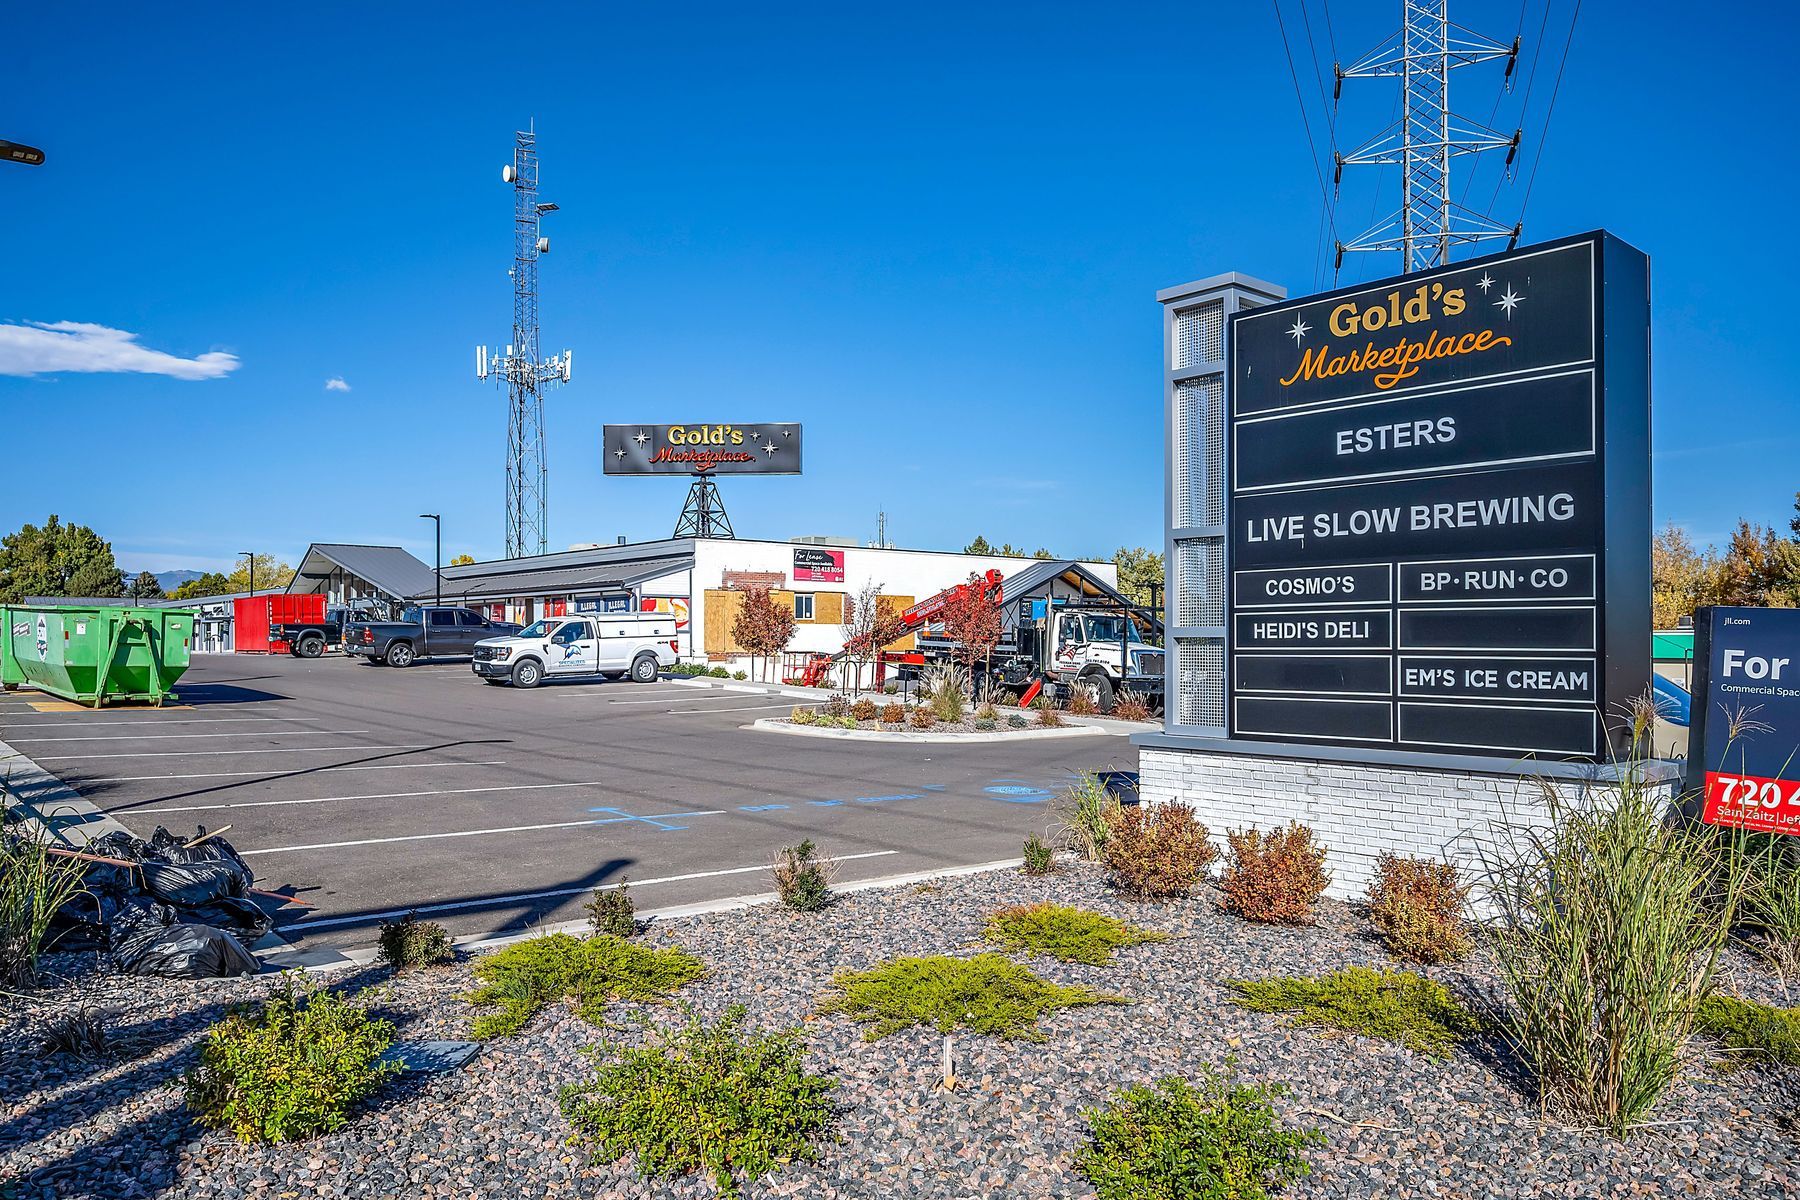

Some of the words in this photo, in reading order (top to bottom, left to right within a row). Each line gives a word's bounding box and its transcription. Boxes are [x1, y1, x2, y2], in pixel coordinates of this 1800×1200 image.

[1329, 282, 1467, 337] Gold's
[1279, 329, 1512, 389] Marketplace
[667, 425, 744, 446] Gold's
[1336, 416, 1456, 456] ESTERS
[648, 447, 756, 472] Marketplace
[1247, 515, 1305, 542] LIVE
[1313, 507, 1401, 538] SLOW
[1410, 492, 1575, 531] BREWING
[1265, 576, 1355, 596] COSMO'S
[1254, 621, 1319, 639] HEIDI'S
[1325, 621, 1369, 639] DELI
[1723, 617, 1751, 626] jll.com
[1723, 649, 1790, 680] For
[1405, 668, 1455, 687] EM'S
[1465, 669, 1498, 688] ICE
[1506, 670, 1588, 690] CREAM
[1721, 684, 1775, 694] Commercial
[1718, 777, 1782, 809] 720
